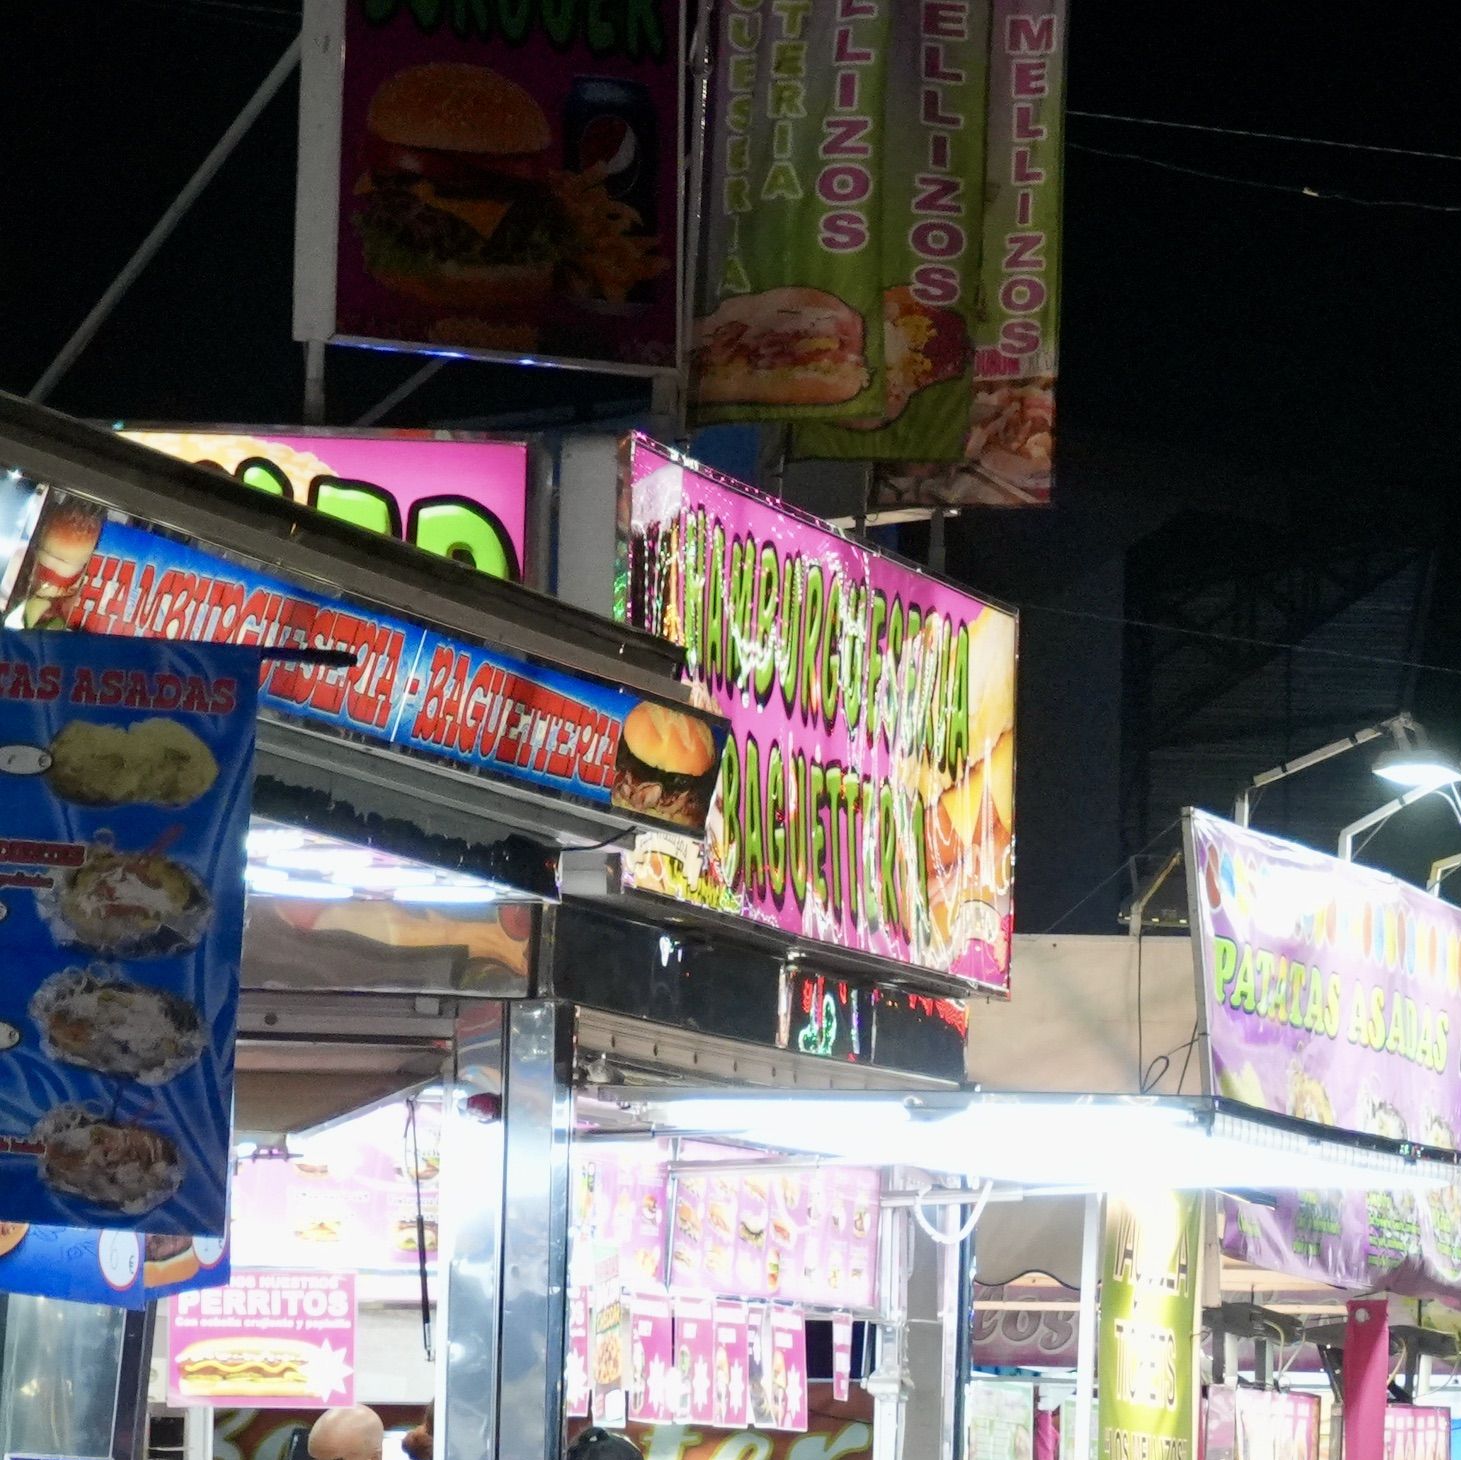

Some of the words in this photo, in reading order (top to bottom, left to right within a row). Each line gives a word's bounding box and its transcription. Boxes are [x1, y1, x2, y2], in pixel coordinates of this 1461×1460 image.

[999, 15, 1056, 357] MELLIZOS
[71, 665, 236, 715] ASADAS
[413, 643, 622, 787] BAGUETTERIA
[1213, 935, 1342, 1040] PATATAS
[1348, 980, 1450, 1074] ASADAS
[178, 1288, 350, 1317] PERRITOS
